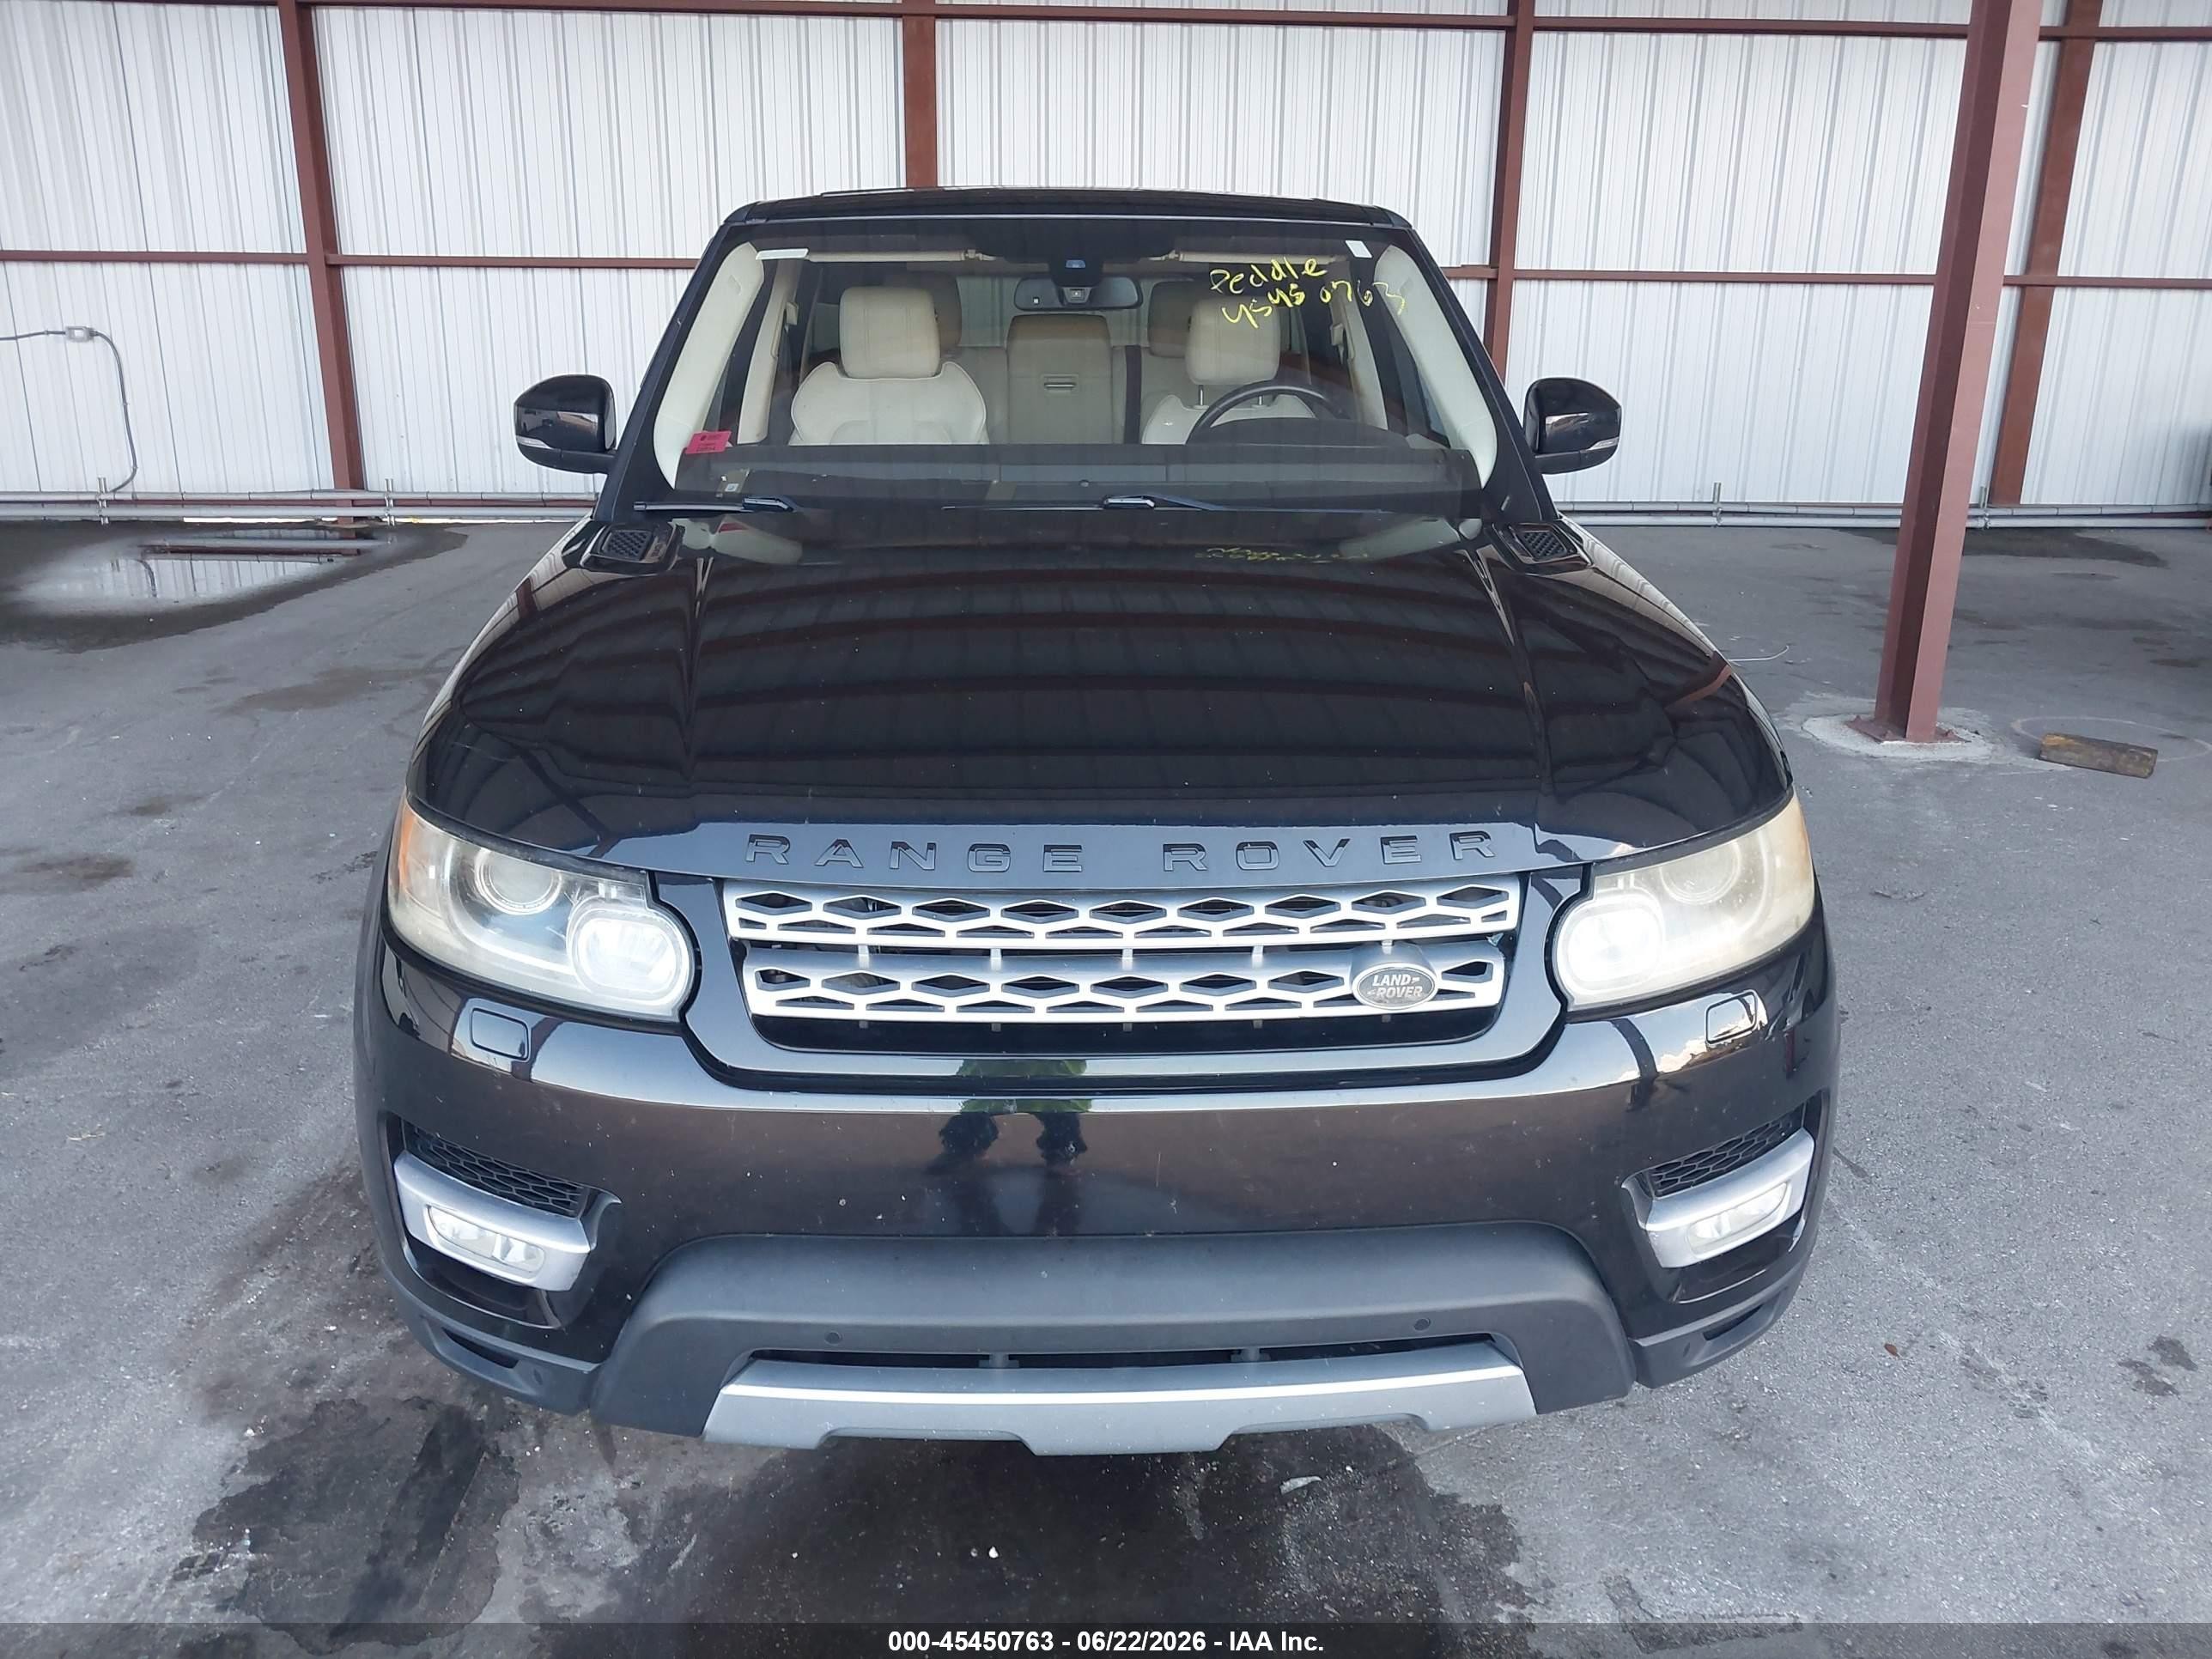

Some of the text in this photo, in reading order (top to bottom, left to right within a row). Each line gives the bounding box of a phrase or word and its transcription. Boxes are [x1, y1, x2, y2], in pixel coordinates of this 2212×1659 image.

[744, 830, 1497, 873] RANGE ROVER
[1371, 973, 1411, 987] LAND
[1376, 985, 1423, 999] ROVER
